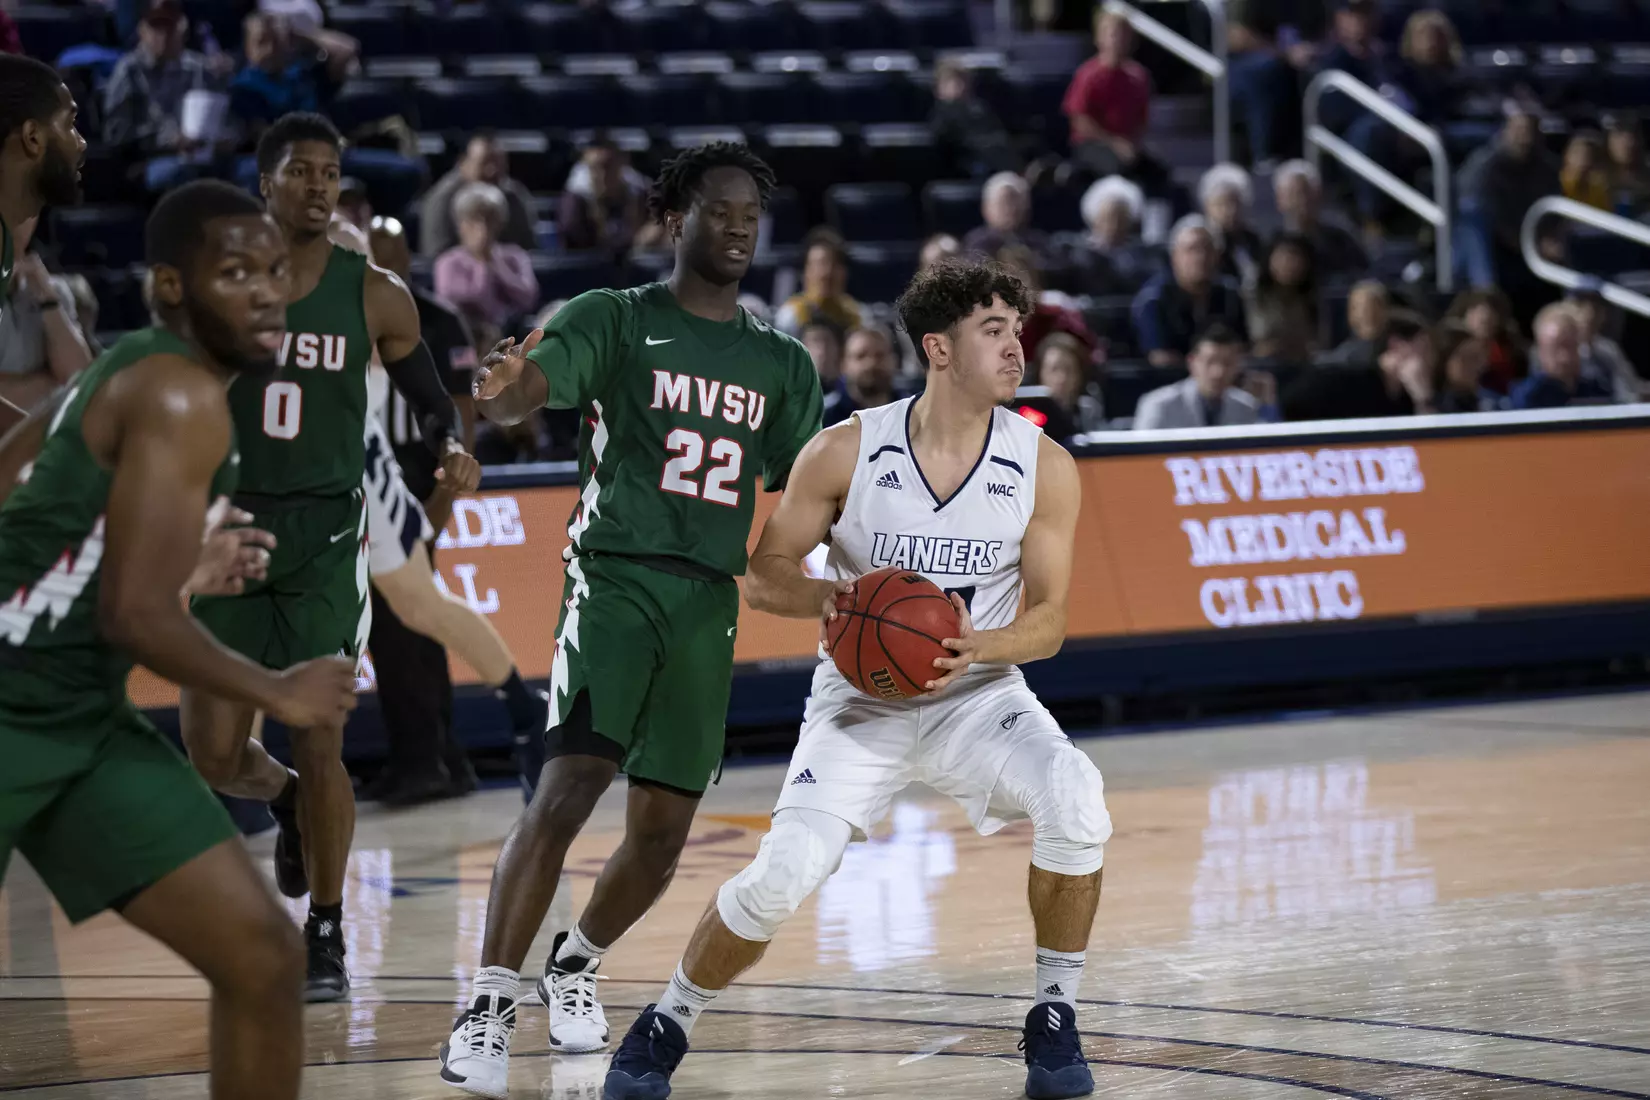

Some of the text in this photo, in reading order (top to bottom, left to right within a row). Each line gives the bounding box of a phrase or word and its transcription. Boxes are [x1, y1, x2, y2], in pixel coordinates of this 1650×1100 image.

[275, 332, 346, 372] VSU
[262, 381, 302, 440] 0
[649, 369, 766, 432] MVSU
[659, 428, 745, 508] 22
[875, 480, 903, 490] adidas
[986, 482, 1015, 497] WAC
[1164, 446, 1425, 505] RIVERSIDE
[871, 532, 1003, 575] LANCERS
[1180, 507, 1407, 567] MEDICAL
[1200, 570, 1365, 628] CLINIC
